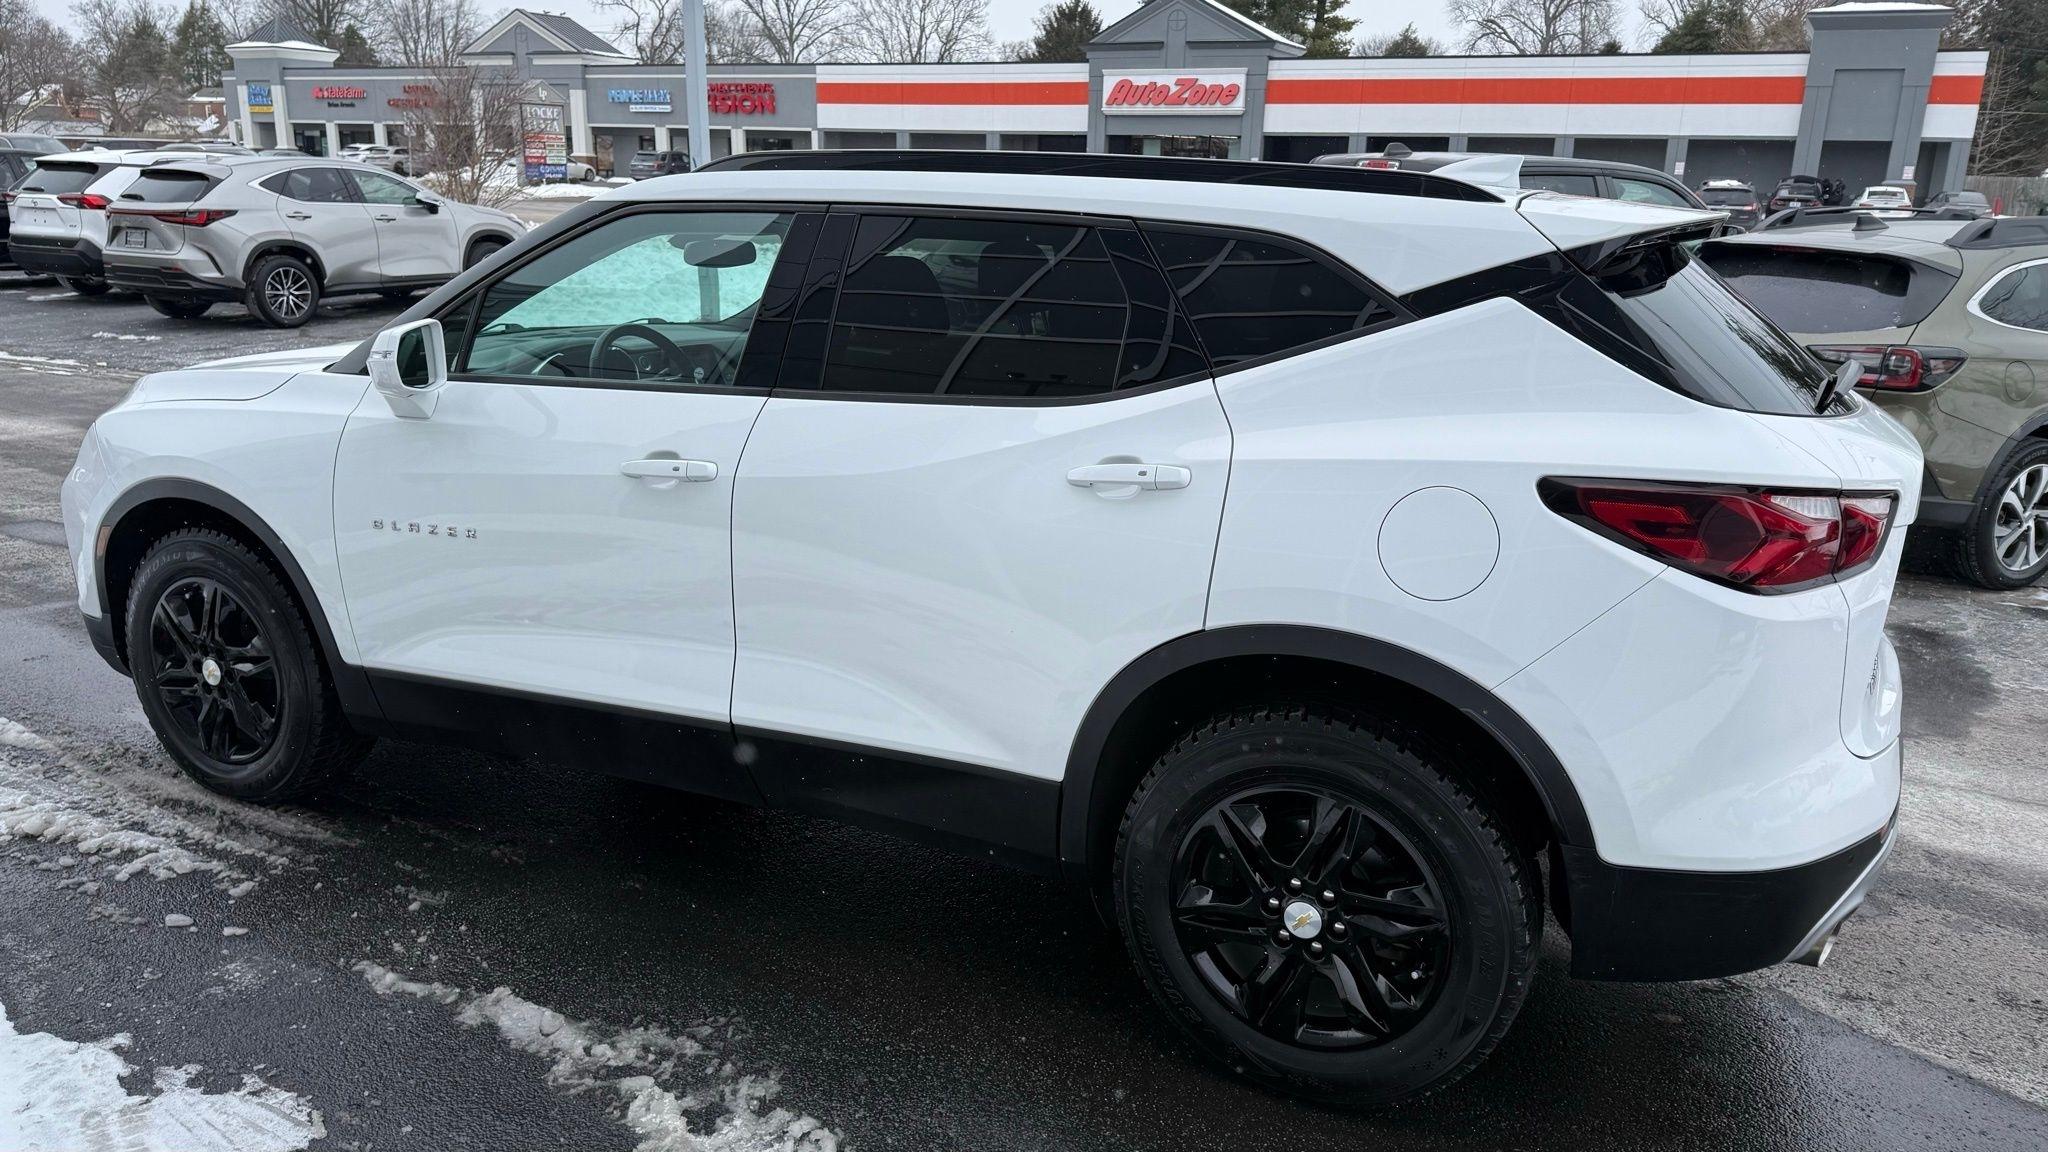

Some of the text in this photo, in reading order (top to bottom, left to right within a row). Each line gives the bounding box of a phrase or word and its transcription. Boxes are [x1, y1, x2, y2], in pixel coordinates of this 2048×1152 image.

[1106, 78, 1240, 106] AutoZone
[526, 106, 560, 119] LOCKE
[708, 95, 775, 115] ISION
[372, 519, 478, 539] BLAZER
